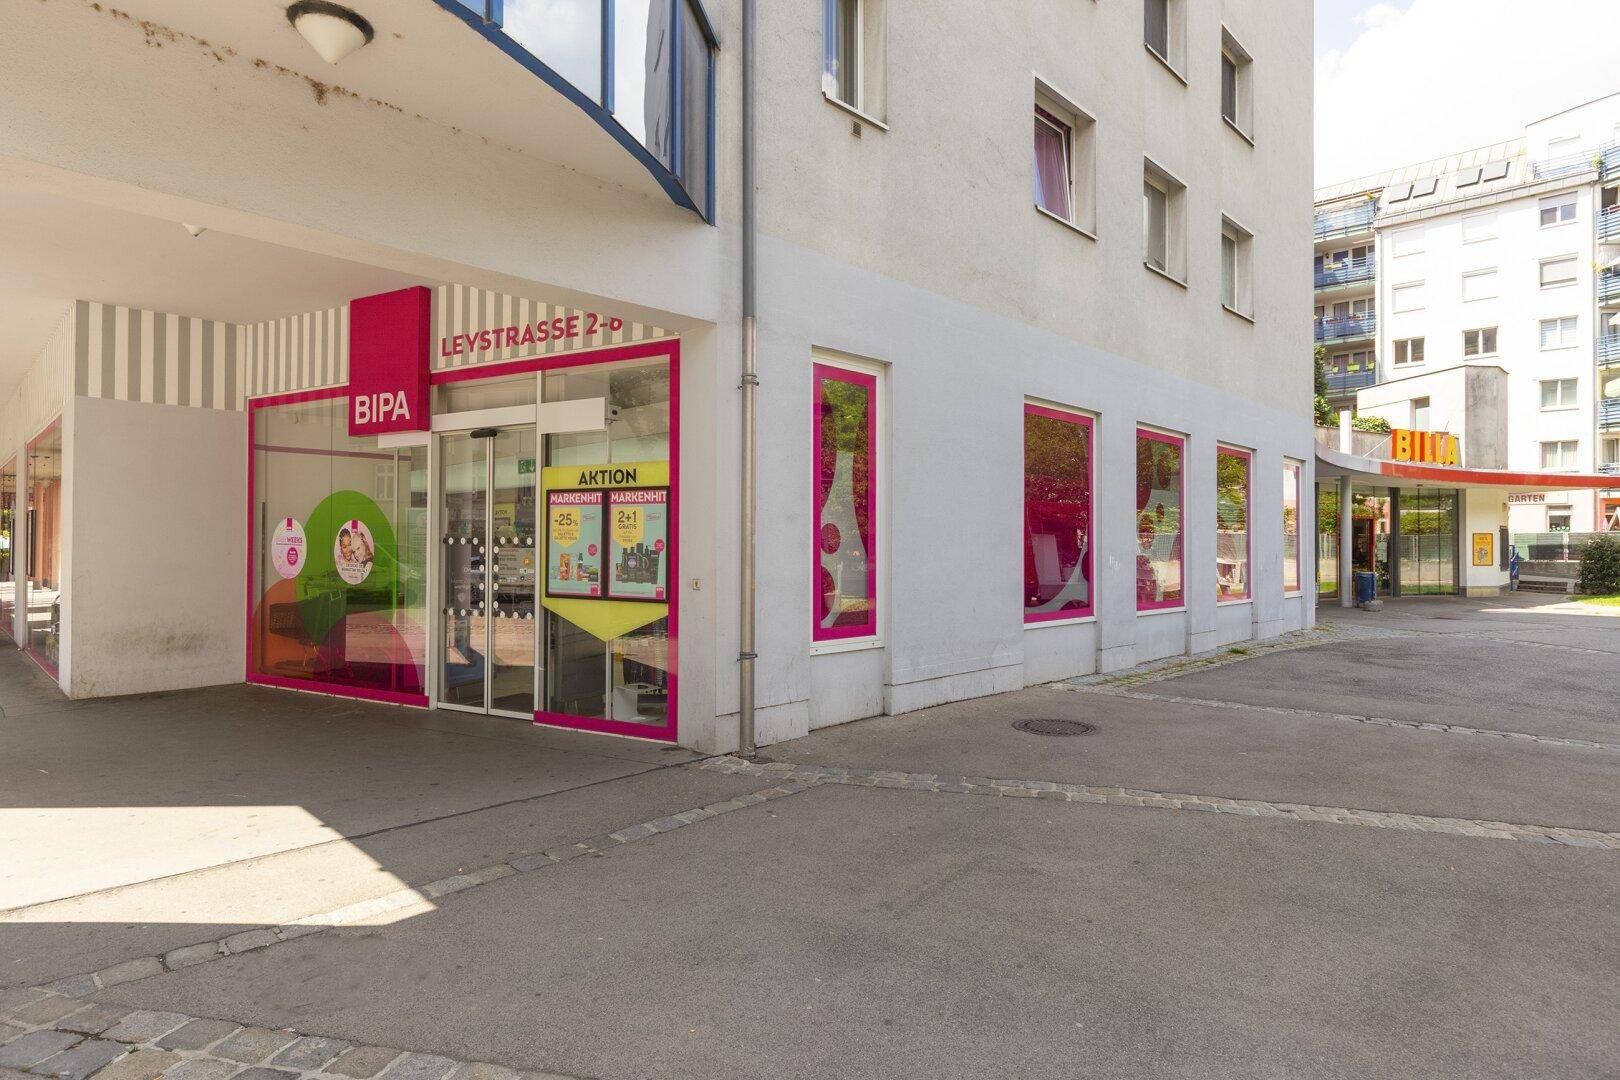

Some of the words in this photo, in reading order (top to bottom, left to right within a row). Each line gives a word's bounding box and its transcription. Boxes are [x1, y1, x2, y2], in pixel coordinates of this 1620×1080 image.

[441, 315, 580, 357] LEYSTRASSE
[355, 390, 410, 425] BIPA
[578, 468, 637, 486] AKTION
[550, 492, 602, 504] MARKENHIT
[610, 491, 667, 503] MARKENHIT
[1508, 494, 1545, 503] GARTEN
[618, 510, 637, 523] 2+1
